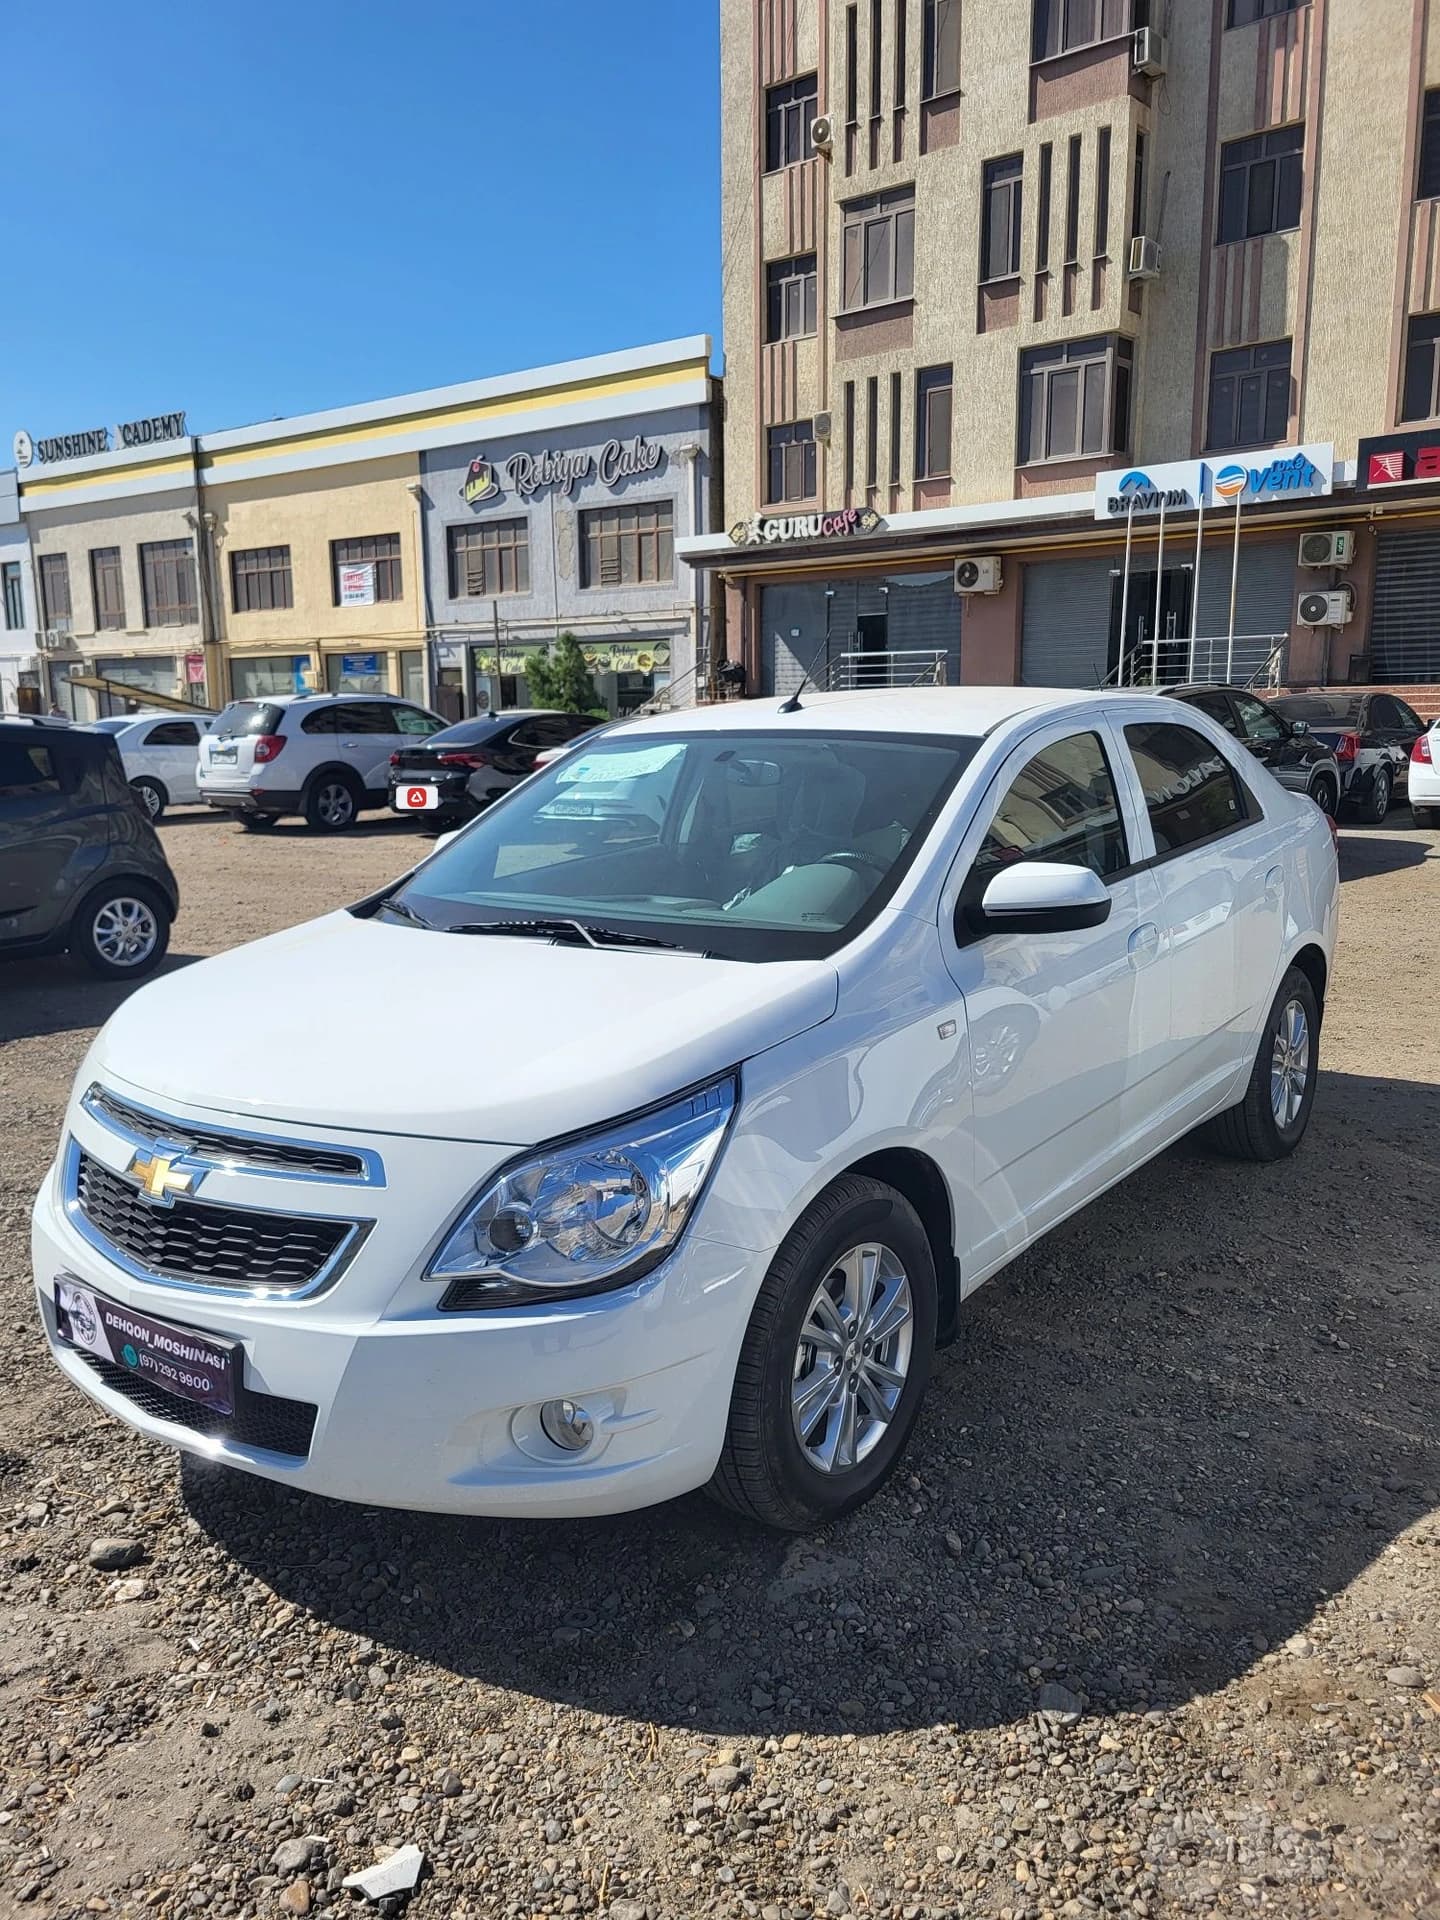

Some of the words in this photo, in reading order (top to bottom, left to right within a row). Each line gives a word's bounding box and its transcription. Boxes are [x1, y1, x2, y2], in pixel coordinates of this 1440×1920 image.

[37, 428, 109, 464] SUNSHINE
[505, 449, 591, 496] Robiya
[597, 435, 661, 488] Cake
[763, 514, 824, 541] GURU
[822, 508, 858, 535] cafe
[105, 1311, 226, 1371] DEHQON_MOSHINASI
[139, 1352, 159, 1374] (97)
[160, 1362, 178, 1381] 292
[179, 1369, 210, 1392] 9900
